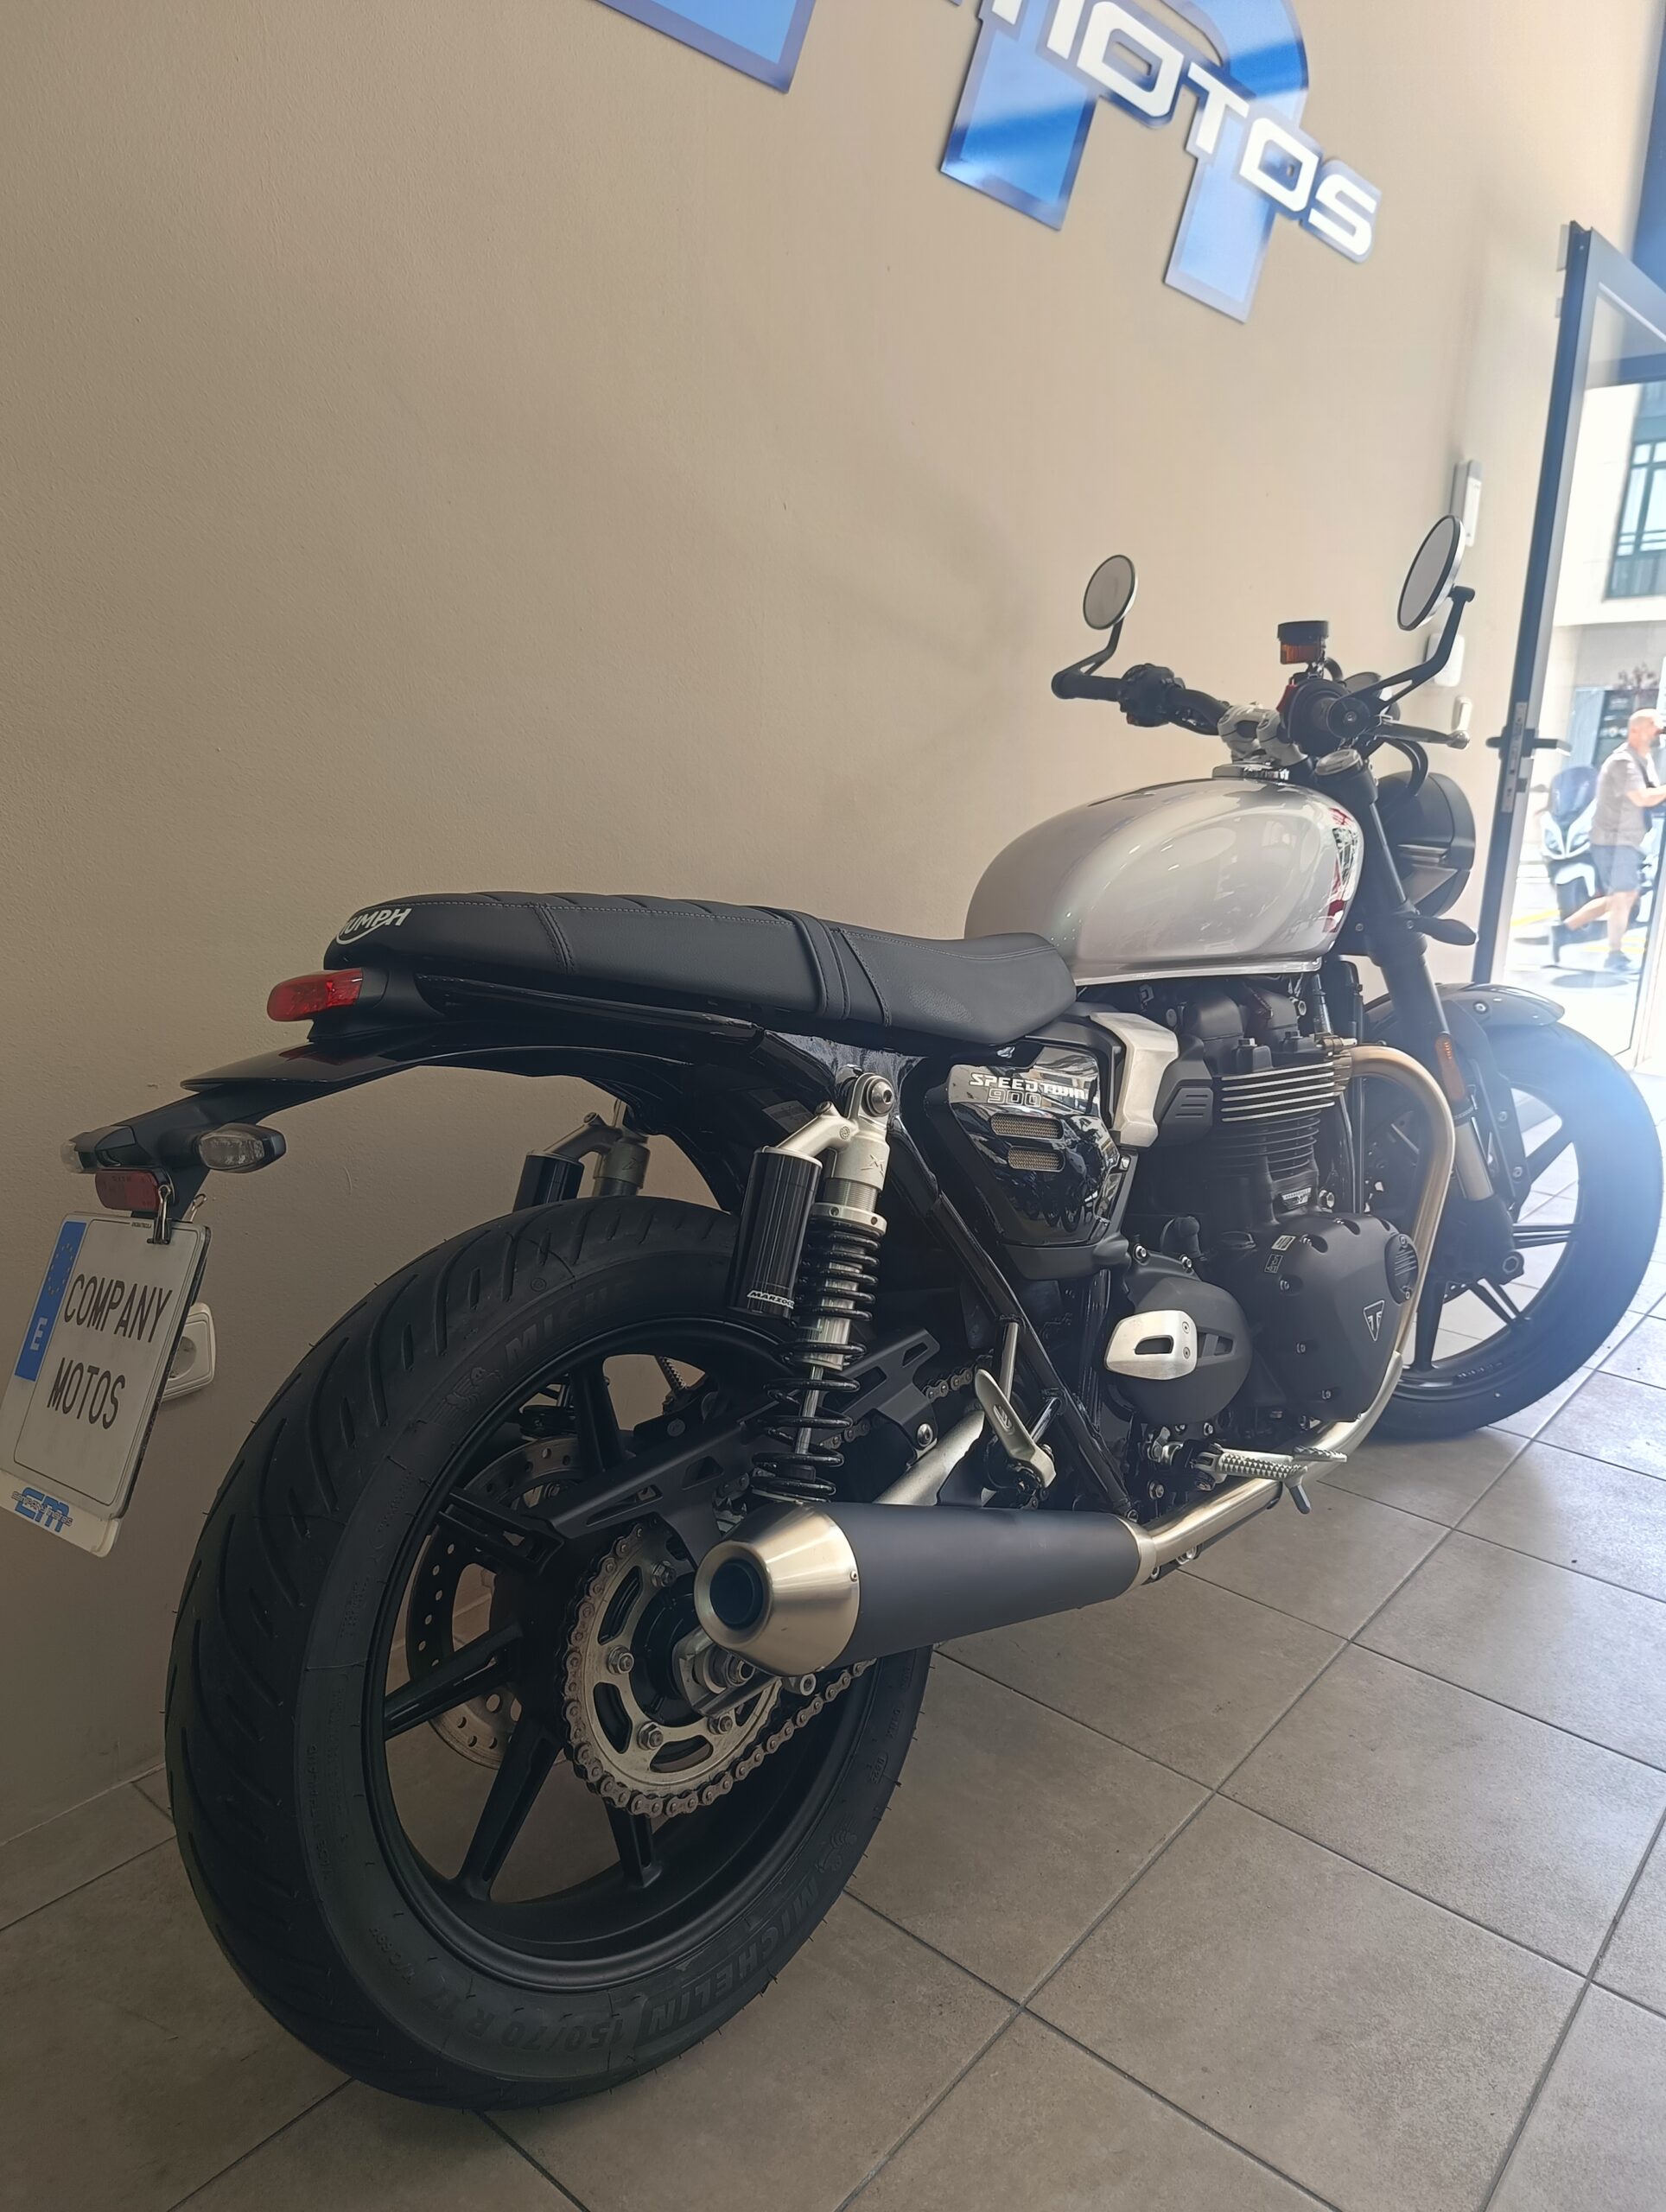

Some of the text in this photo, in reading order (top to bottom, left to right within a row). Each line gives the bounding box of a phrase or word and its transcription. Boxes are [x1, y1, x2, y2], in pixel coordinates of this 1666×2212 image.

[970, 1073, 1088, 1100] SPEED TWIN
[987, 1088, 1041, 1107] 900
[64, 1274, 173, 1343] COMPANY
[30, 1317, 48, 1351] E
[48, 1357, 125, 1430] MOTOS
[650, 1875, 819, 2033] MICHELIN
[499, 2017, 625, 2053] 150/70
